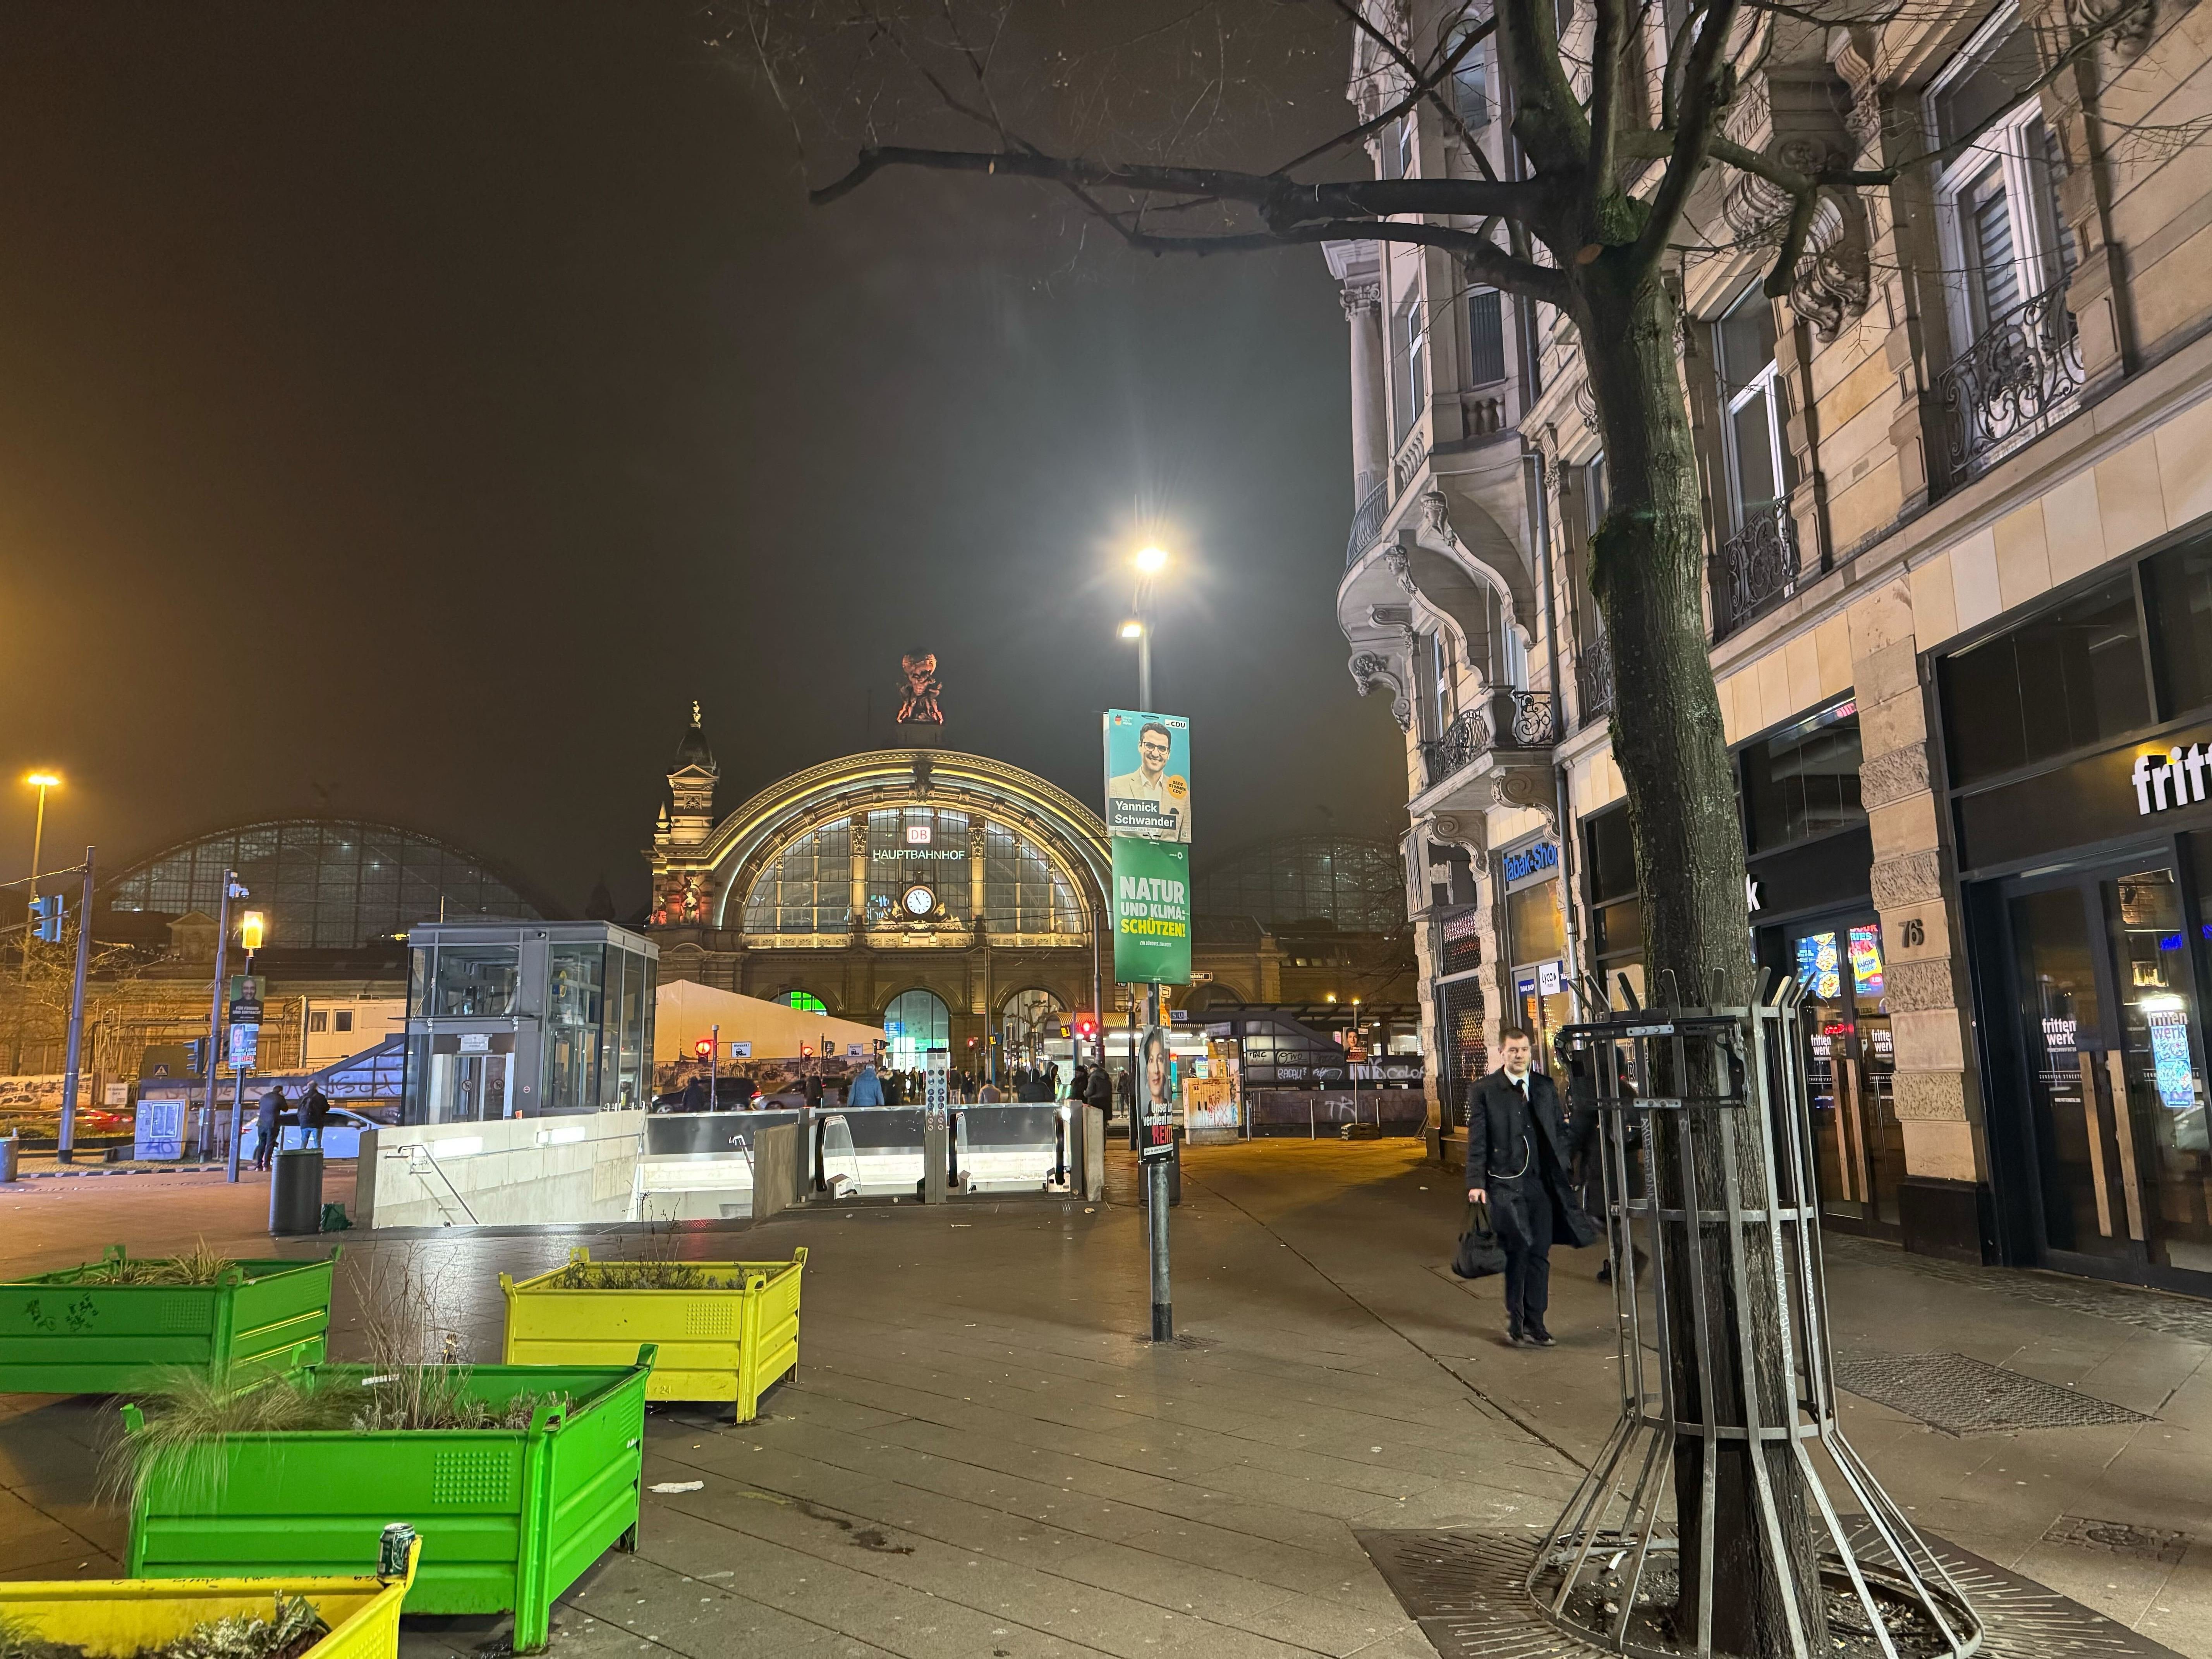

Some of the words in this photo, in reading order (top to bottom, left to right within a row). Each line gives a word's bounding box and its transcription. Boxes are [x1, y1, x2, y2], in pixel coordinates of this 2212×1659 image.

[1115, 800, 1157, 812] Yannick
[1115, 814, 1174, 827] Schwander
[911, 830, 927, 840] DB
[873, 849, 965, 860] HAUPTBAHNHOF
[1120, 876, 1185, 904] NATUR
[1121, 902, 1147, 917] UND
[1121, 917, 1186, 938] SCHÜTZEN!
[1898, 919, 1924, 948] 76
[1850, 932, 1872, 941] RIES
[1542, 972, 1553, 985] Lyca
[2042, 1018, 2076, 1033] fritten
[1810, 1034, 1831, 1046] fritten
[1872, 1029, 1892, 1042] fritte
[2046, 1031, 2075, 1045] werk
[1813, 1044, 1831, 1055] werk
[1875, 1040, 1893, 1052] werk
[1151, 1100, 1167, 1113] Unser
[1143, 1113, 1166, 1127] verdient
